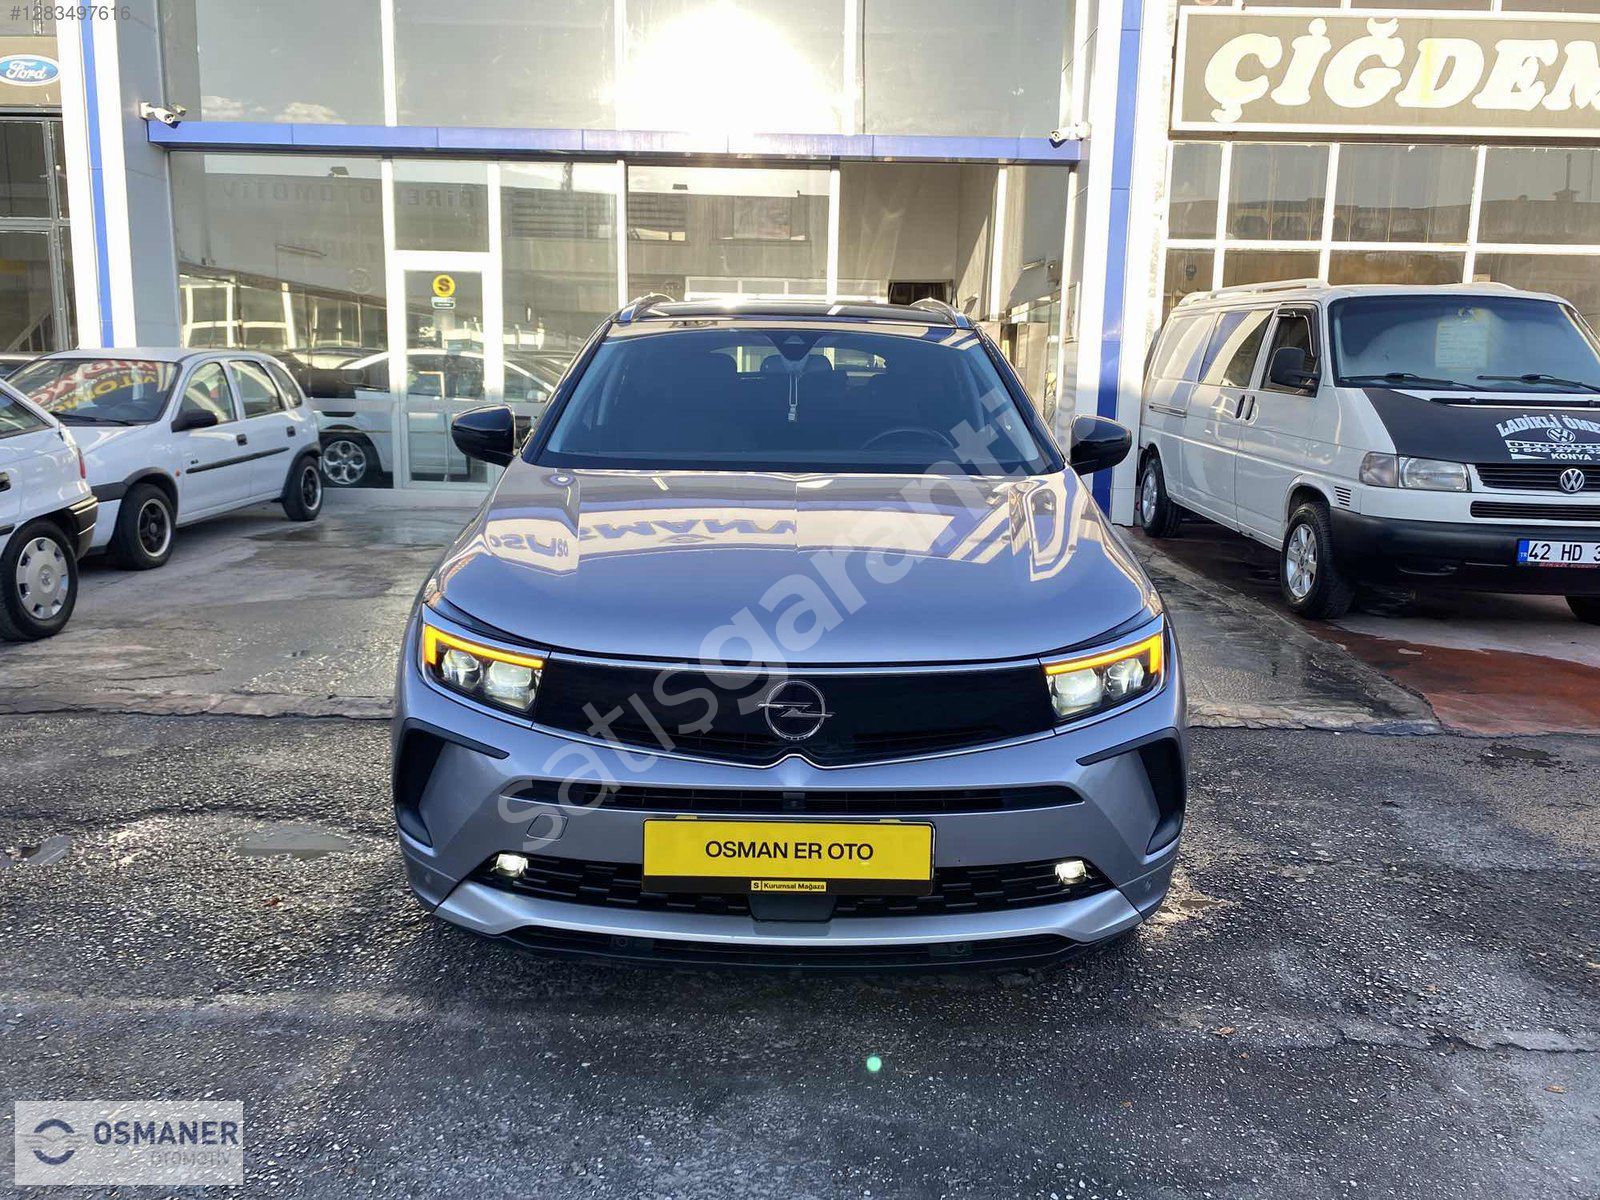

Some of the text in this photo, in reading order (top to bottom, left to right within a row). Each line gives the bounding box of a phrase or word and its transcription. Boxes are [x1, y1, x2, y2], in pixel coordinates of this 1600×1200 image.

[5, 61, 47, 79] Ford
[1550, 453, 1592, 461] KONYA
[1529, 543, 1551, 560] 42
[1561, 544, 1583, 561] HD
[705, 840, 874, 861] OSMAN ER OTO
[763, 882, 797, 890] Kurumsal
[797, 883, 825, 891] Mağaza
